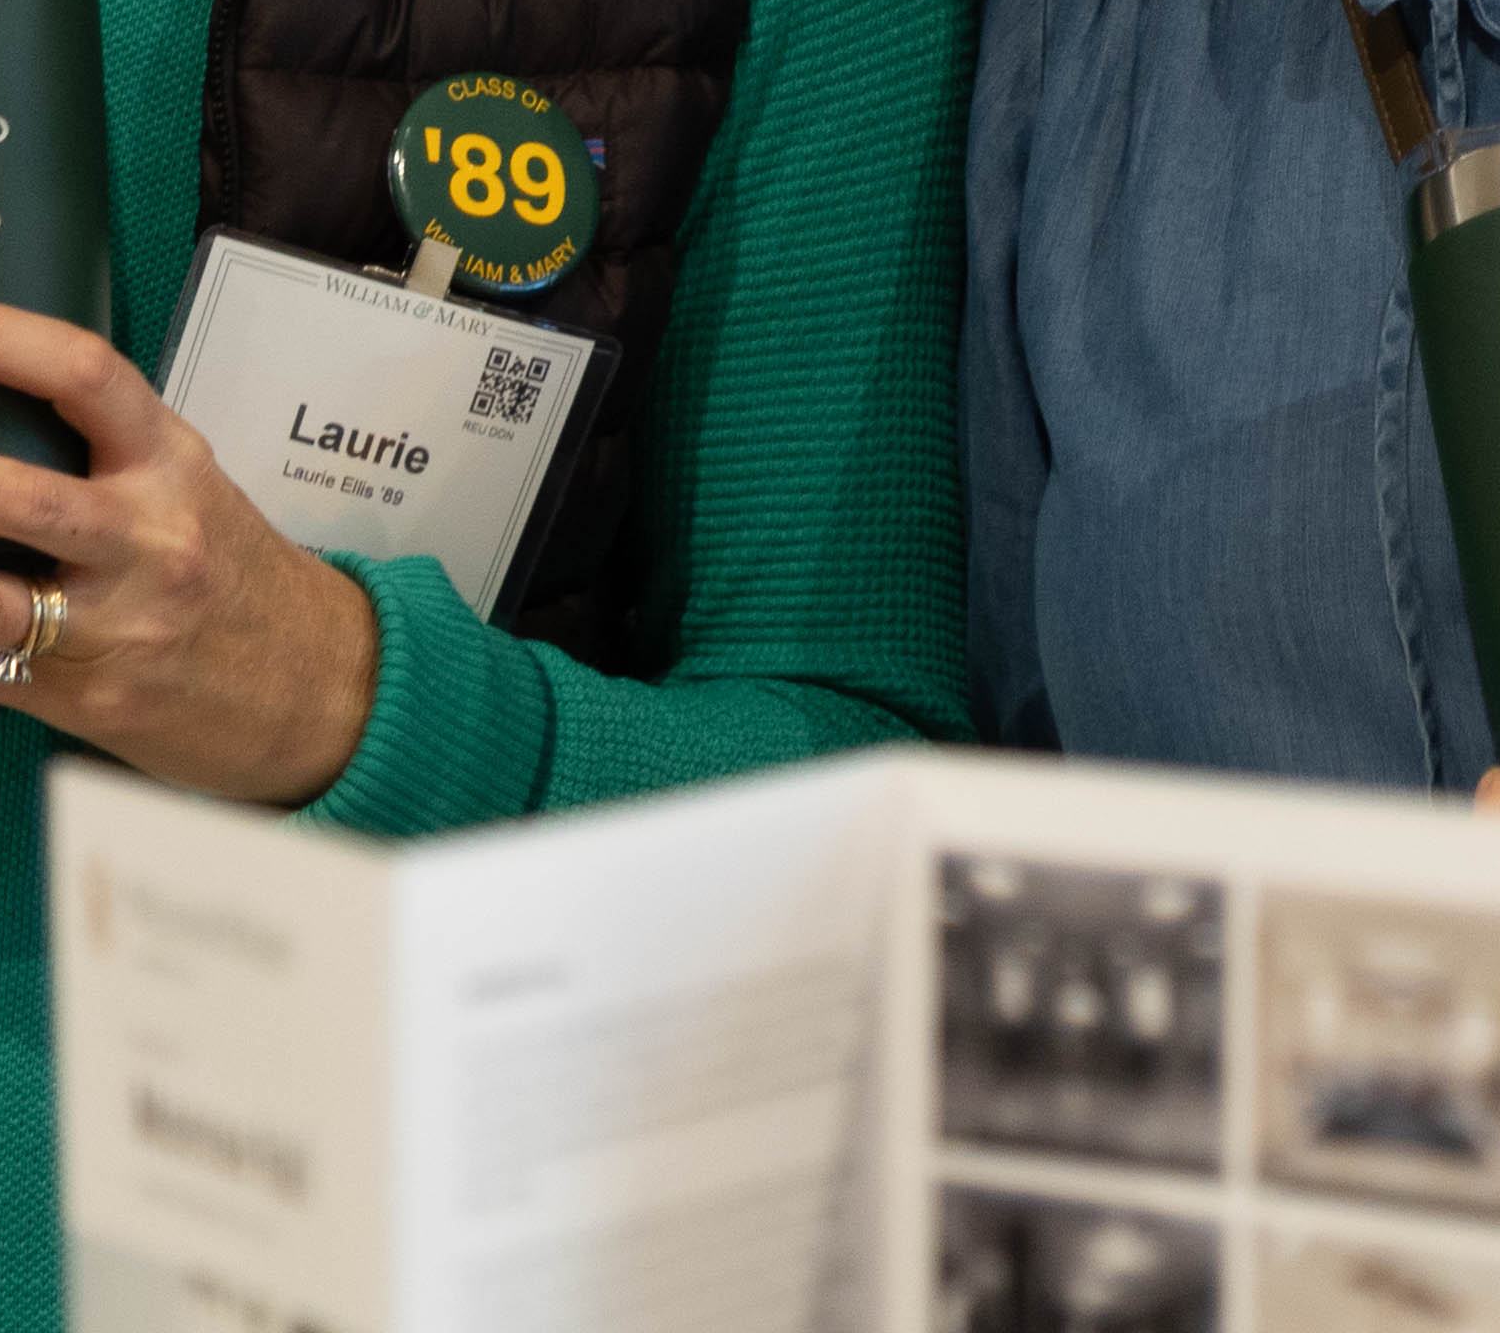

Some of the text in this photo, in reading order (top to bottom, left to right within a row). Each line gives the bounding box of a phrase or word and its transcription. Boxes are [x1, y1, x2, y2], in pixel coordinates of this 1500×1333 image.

[447, 77, 551, 114] CLASS OF
[424, 127, 566, 226] '89
[509, 264, 524, 284] &
[526, 235, 576, 282] MARY
[326, 273, 494, 337] WILLIAM & MARY
[288, 403, 431, 475] Laurie
[282, 459, 404, 506] Laurie Ellis '89
